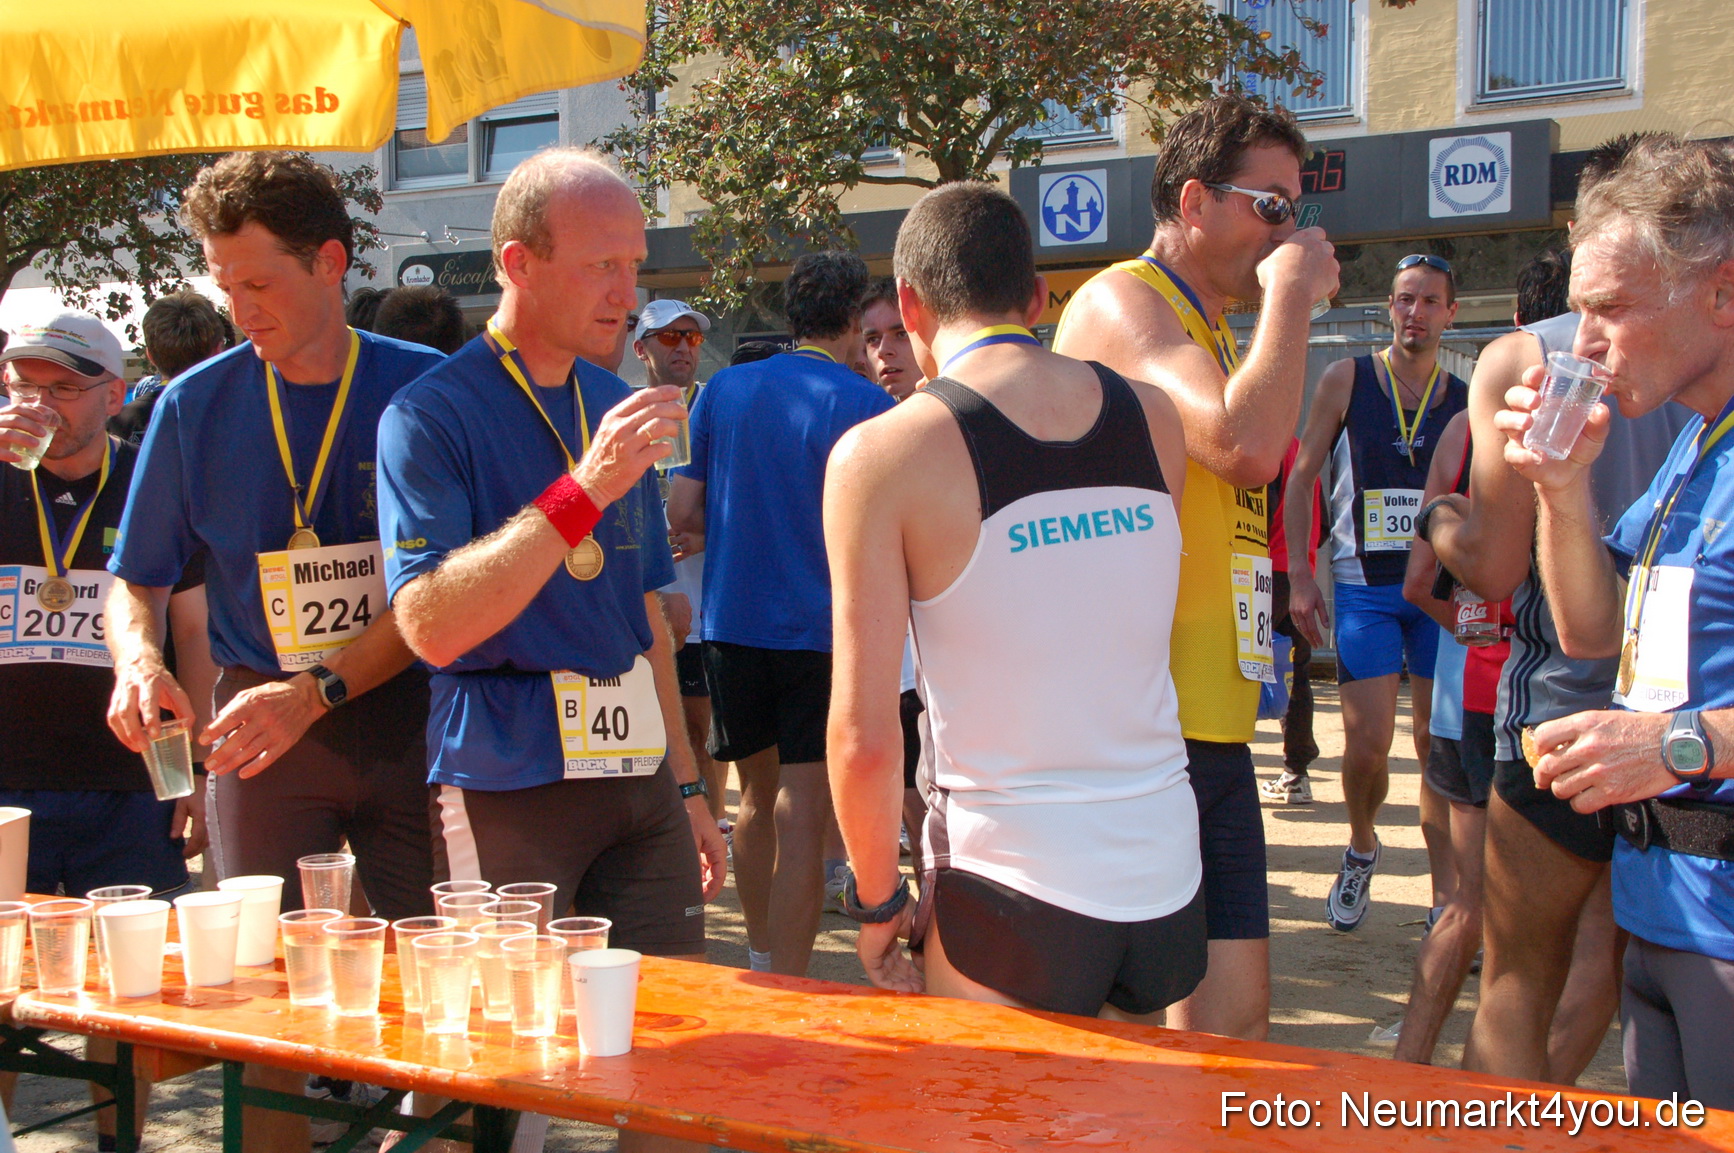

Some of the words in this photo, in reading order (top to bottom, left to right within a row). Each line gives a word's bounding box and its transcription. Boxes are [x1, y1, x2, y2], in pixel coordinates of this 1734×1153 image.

[1443, 161, 1497, 187] RDM
[1383, 495, 1419, 507] Volker
[1369, 512, 1378, 523] B
[1008, 503, 1155, 554] SIEMENS
[294, 555, 376, 584] Michael
[0, 604, 12, 620] C
[271, 597, 285, 616] C
[302, 594, 372, 636] 224
[1239, 601, 1249, 621] B
[1457, 603, 1488, 624] Cola
[23, 609, 105, 641] 2079
[565, 699, 578, 718] B
[591, 705, 630, 741] 40
[566, 758, 608, 772] BOCK
